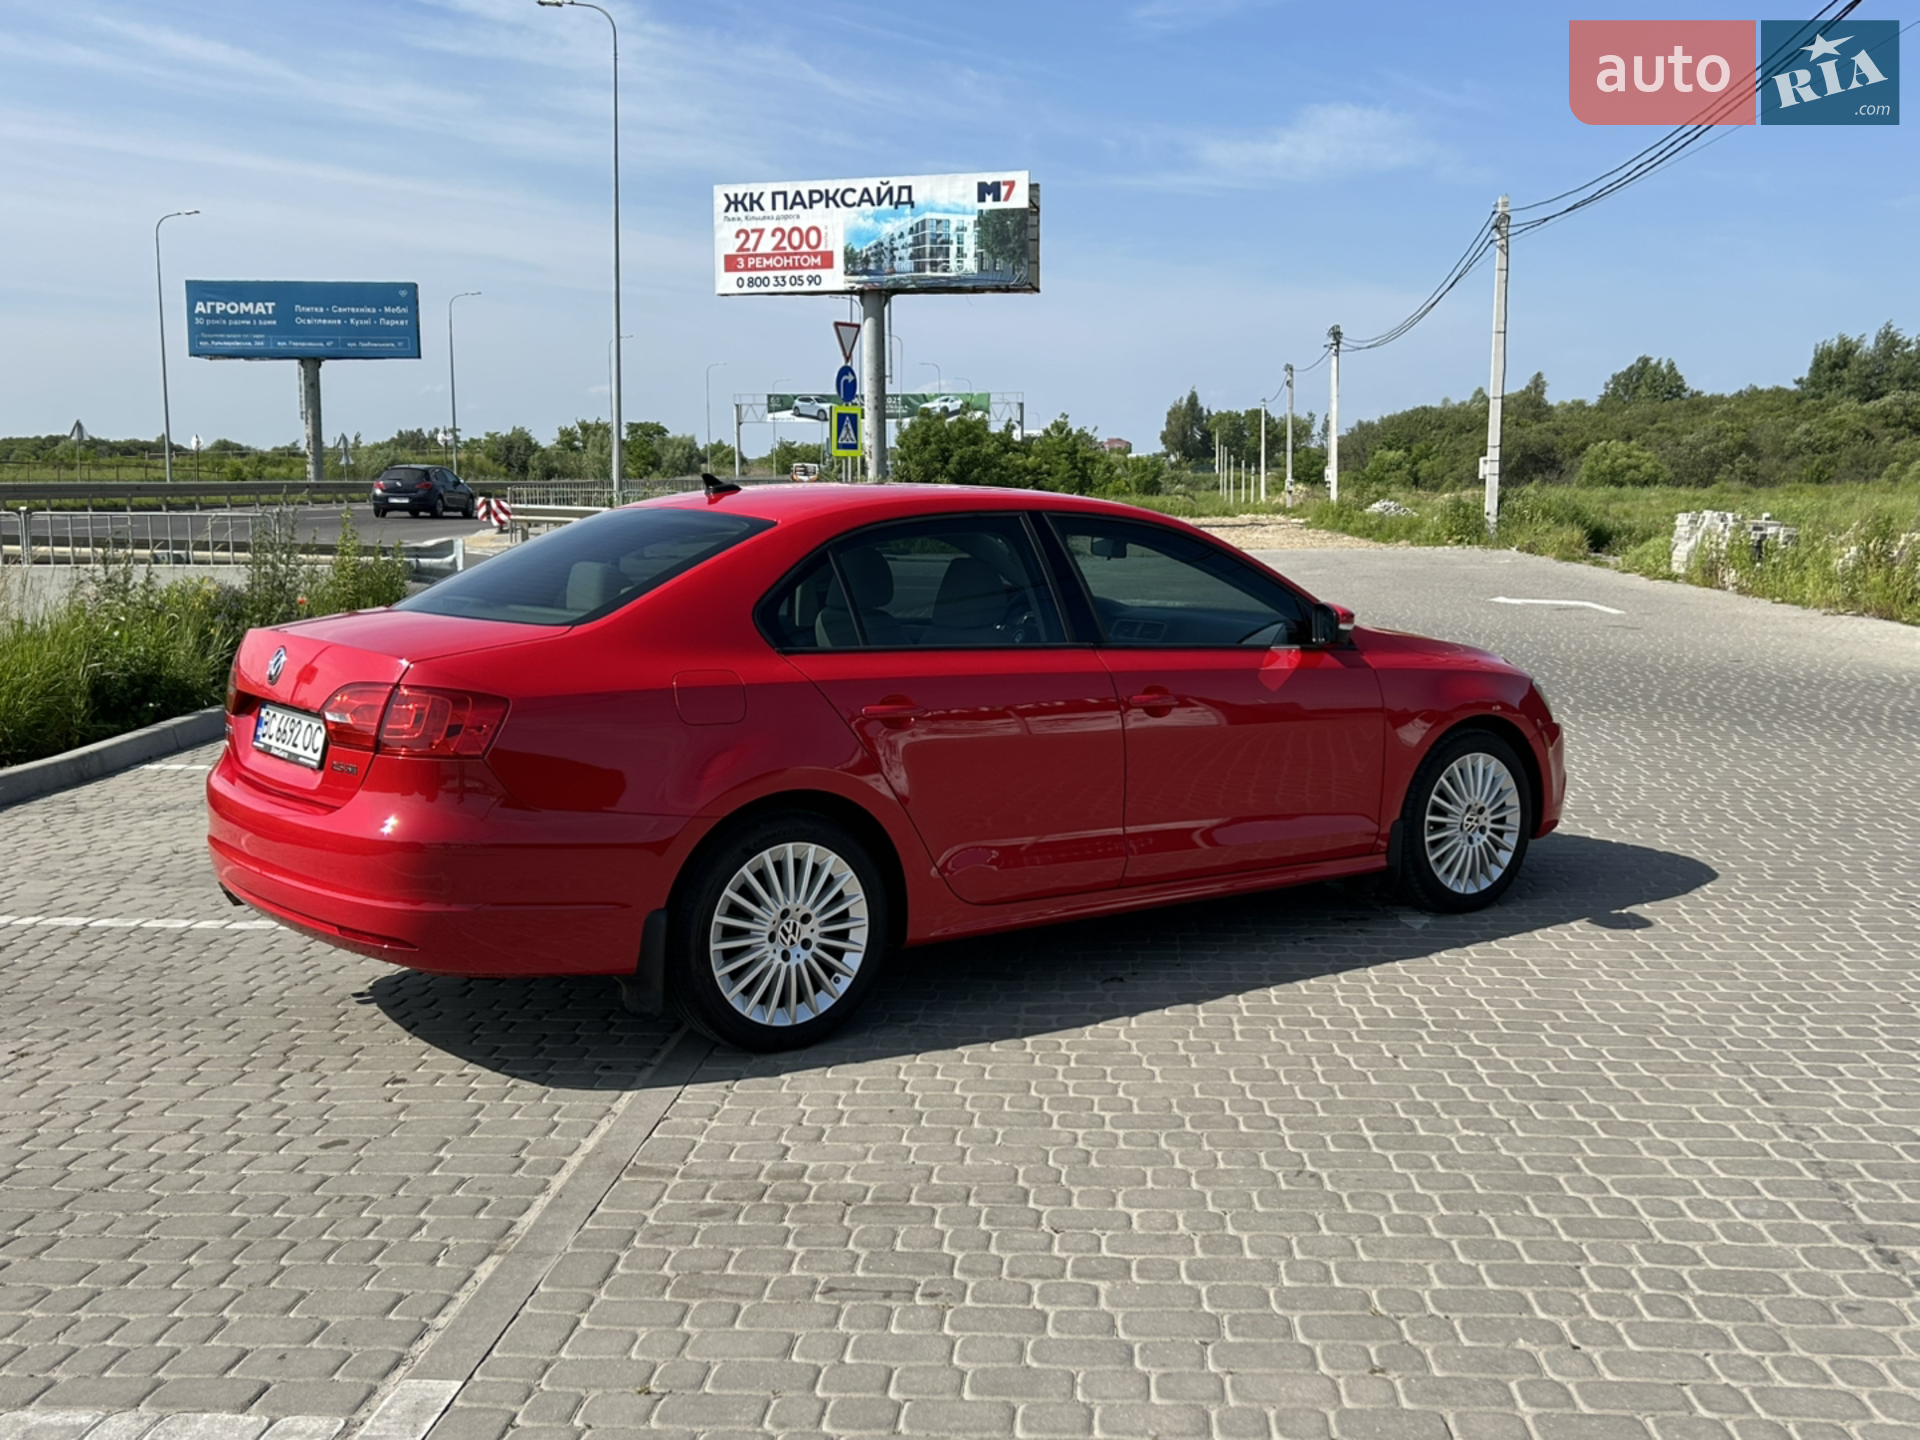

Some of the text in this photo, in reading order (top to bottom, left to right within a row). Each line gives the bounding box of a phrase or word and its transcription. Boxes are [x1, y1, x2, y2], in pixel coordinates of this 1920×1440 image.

[724, 180, 915, 213] ЖК ПАРКСАЙД
[977, 180, 1016, 203] M7
[775, 213, 801, 221] дорога
[735, 228, 765, 252] 27
[771, 225, 822, 251] 200
[747, 254, 821, 268] РЕМОНТОМ
[747, 276, 770, 288] 800
[773, 275, 787, 287] 33
[789, 275, 804, 286] 05
[806, 274, 822, 286] 90
[194, 301, 276, 315] АГРОМАТ
[294, 304, 409, 314] Плитка Сантехніка Меблі
[206, 318, 227, 326] років
[295, 316, 409, 327] Освітлення Кухні Паркет
